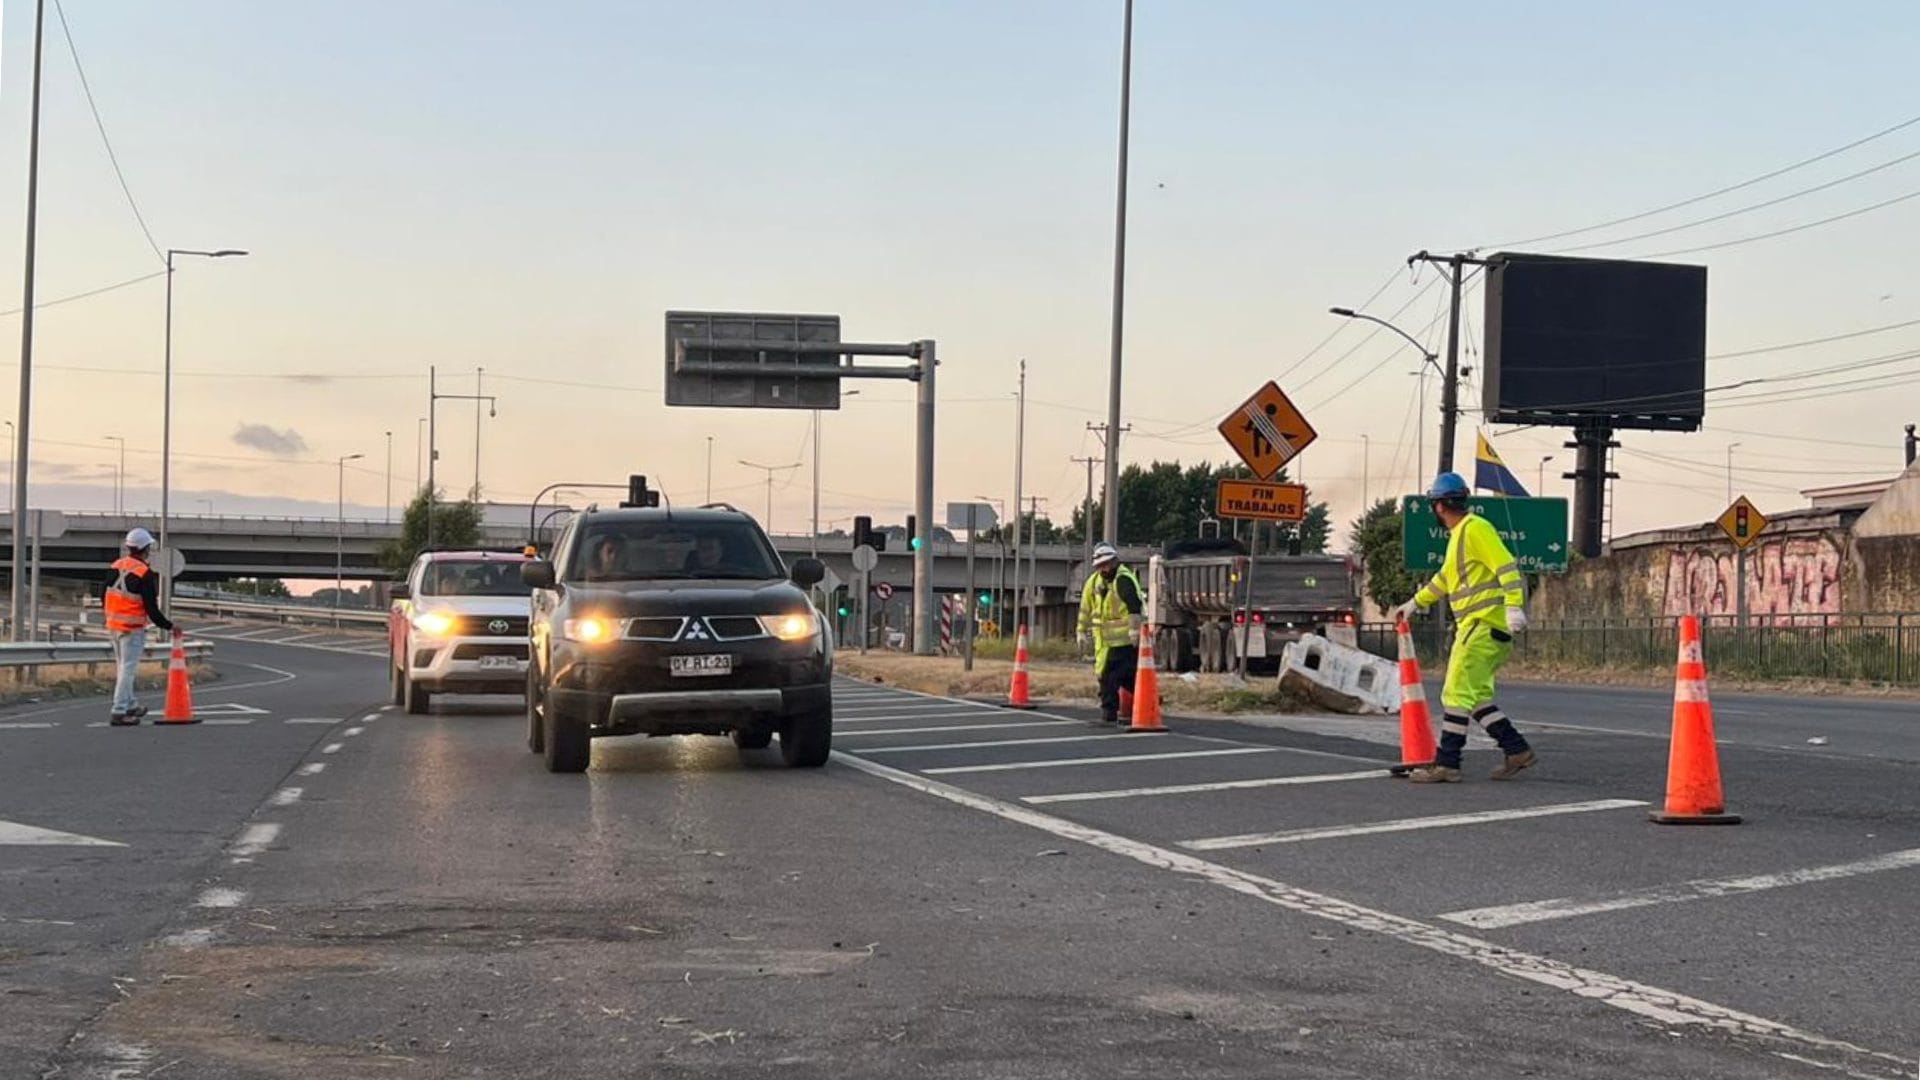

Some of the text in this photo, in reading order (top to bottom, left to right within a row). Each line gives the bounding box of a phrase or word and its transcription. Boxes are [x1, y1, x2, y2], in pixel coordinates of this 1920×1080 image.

[1252, 488, 1274, 500] FIN
[1227, 499, 1296, 515] TRABAJOS
[1498, 530, 1527, 540] mas
